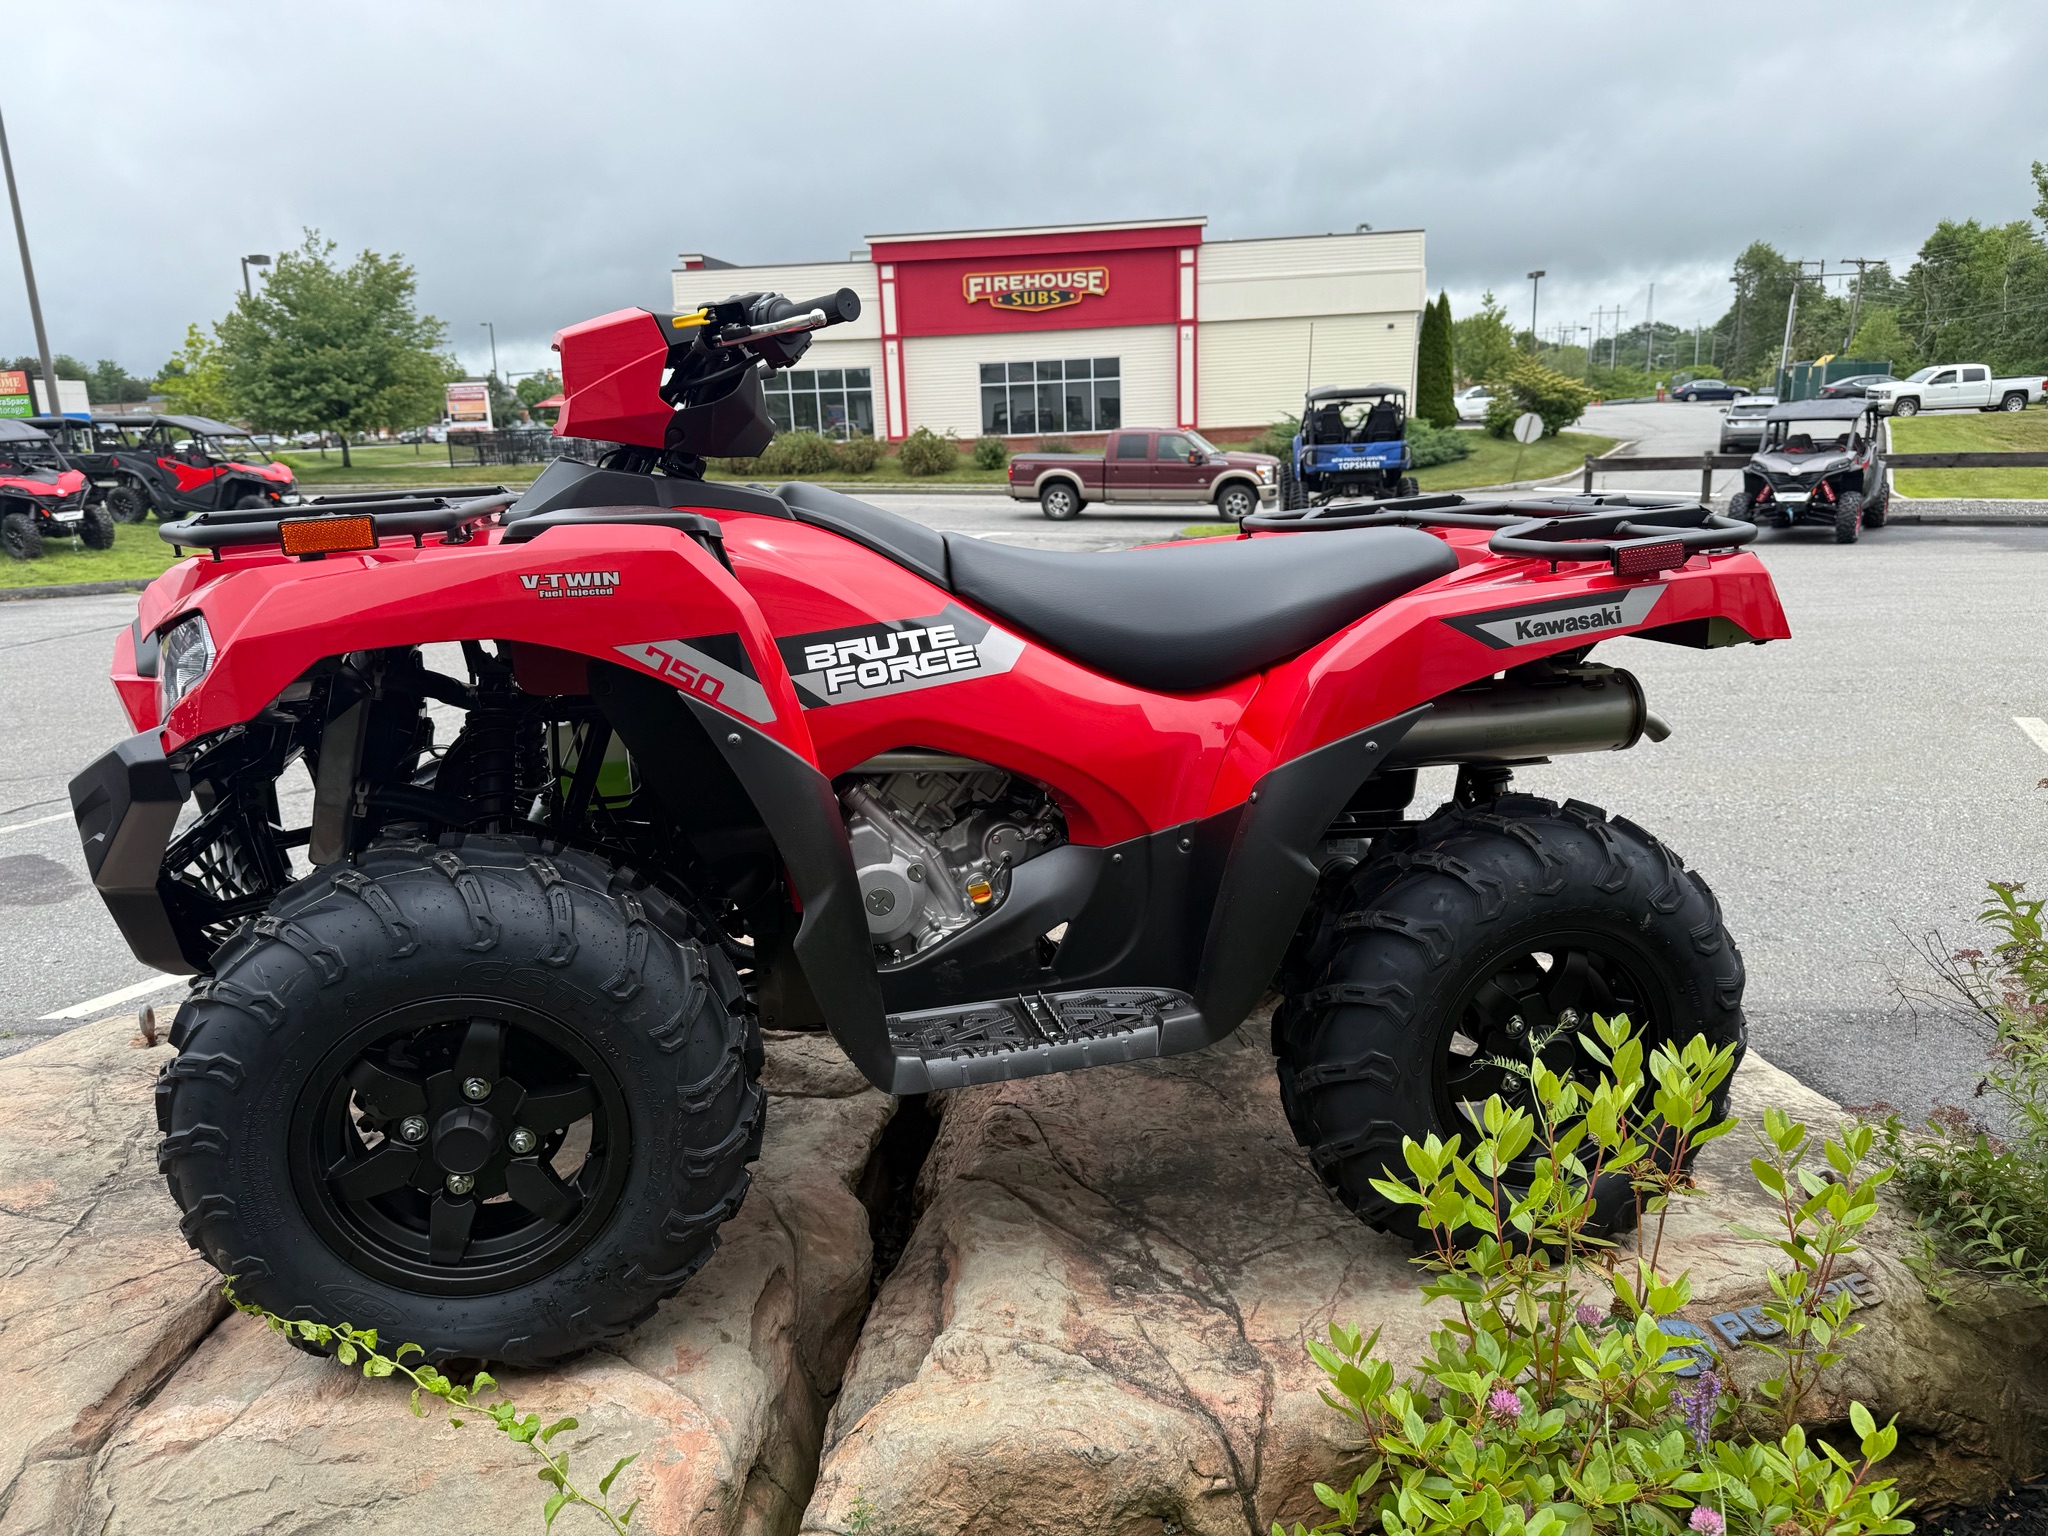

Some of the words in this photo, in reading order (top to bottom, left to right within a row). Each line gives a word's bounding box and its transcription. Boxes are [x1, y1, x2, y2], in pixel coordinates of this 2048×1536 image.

[968, 270, 1105, 303] FIREHOUSE
[1011, 290, 1061, 306] SUBS
[0, 398, 29, 407] aSpace
[1337, 461, 1380, 470] TOPSHAM
[519, 571, 620, 590] V-TWIN
[539, 589, 563, 598] Fuel
[566, 587, 614, 598] Injected
[1515, 606, 1623, 640] Kawasaki
[804, 624, 959, 671] BRUTE
[645, 645, 725, 701] 750
[826, 645, 979, 693] FORCE
[458, 960, 597, 1011] CST
